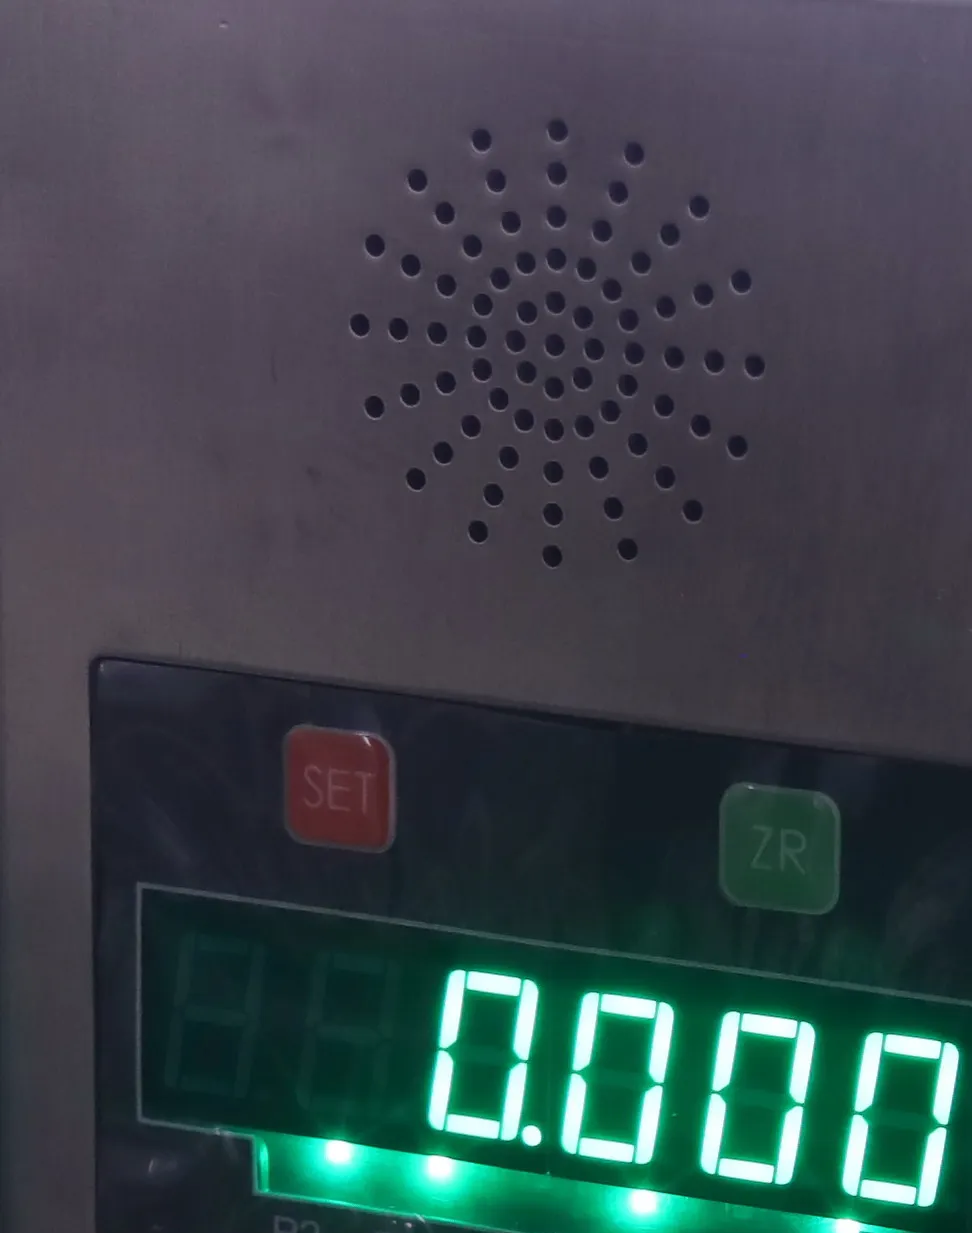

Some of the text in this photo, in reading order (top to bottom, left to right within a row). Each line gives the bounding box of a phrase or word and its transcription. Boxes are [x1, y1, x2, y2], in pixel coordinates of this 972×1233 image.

[302, 764, 376, 816] SET
[748, 824, 808, 874] ZR
[426, 968, 961, 1208] 0.000
